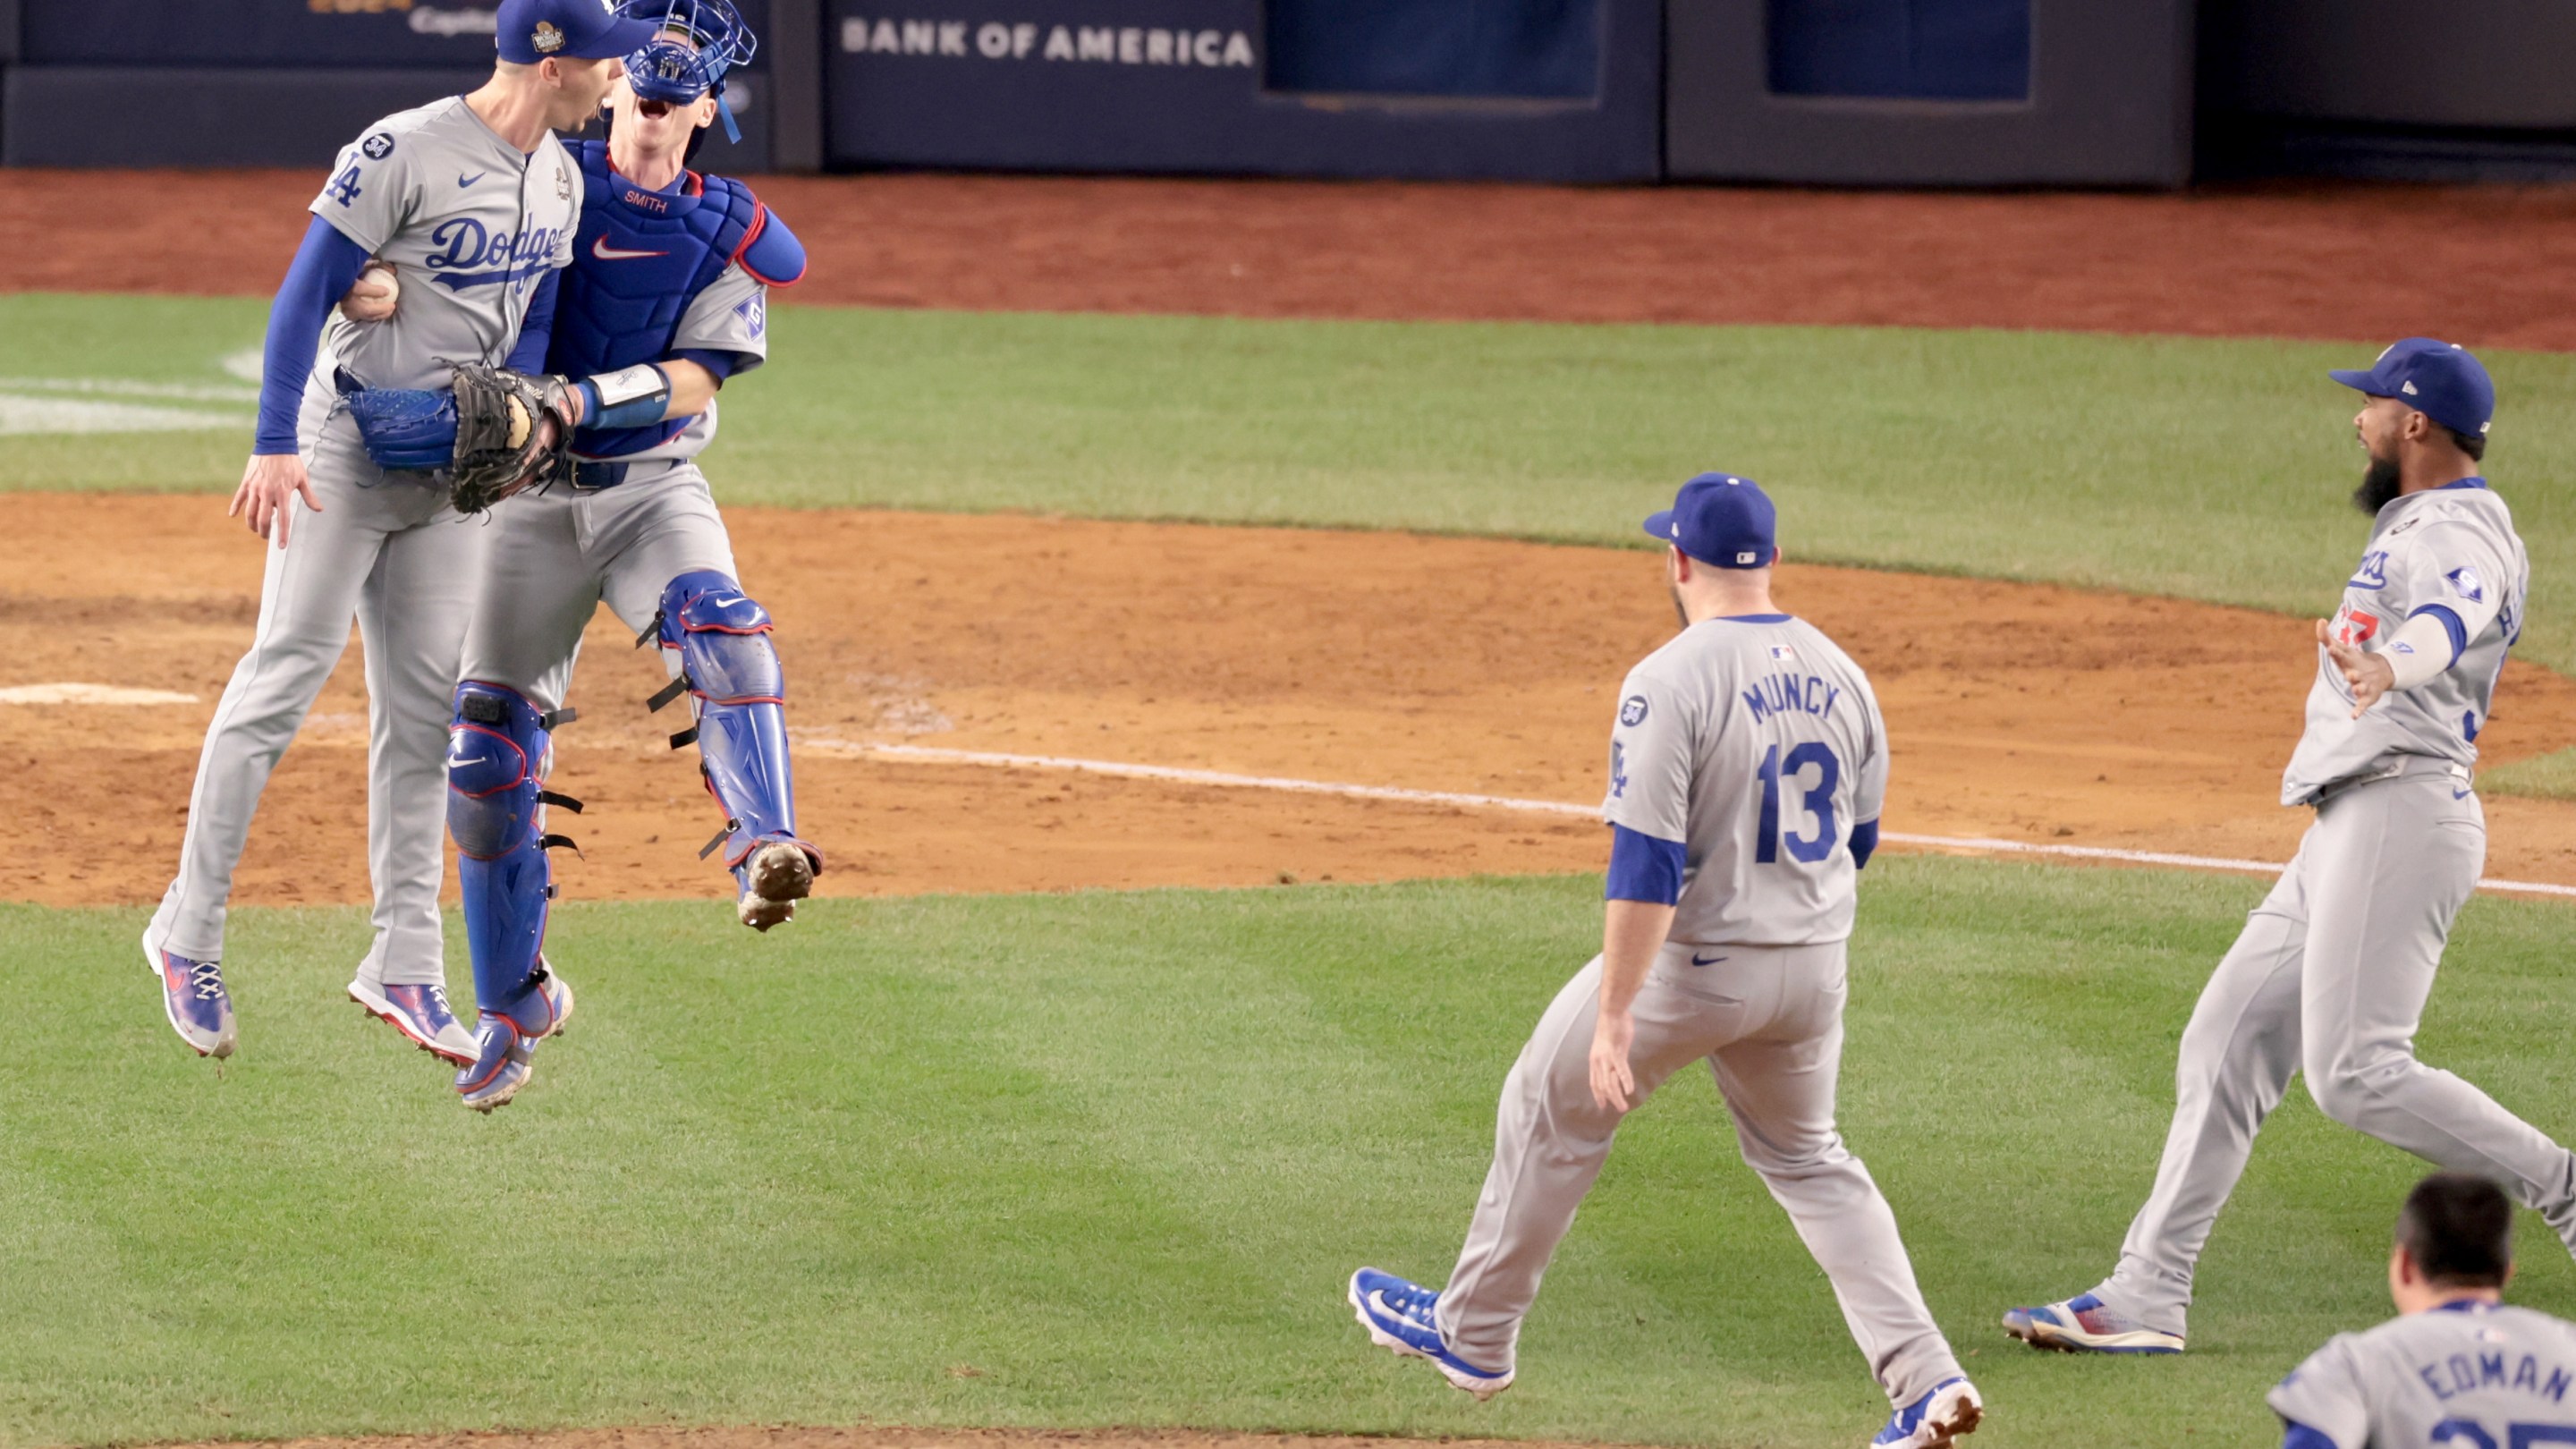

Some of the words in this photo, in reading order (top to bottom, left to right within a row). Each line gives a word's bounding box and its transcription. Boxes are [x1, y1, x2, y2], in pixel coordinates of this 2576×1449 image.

[840, 16, 968, 57] BANK
[976, 21, 1038, 60] OF
[1043, 24, 1254, 67] AMERICA
[365, 139, 387, 157] 34
[326, 151, 361, 208] LA
[624, 190, 667, 214] SMITH
[1742, 674, 1839, 724] MUNCY
[1756, 741, 1839, 863] 13
[2420, 1352, 2572, 1405] EDMAN
